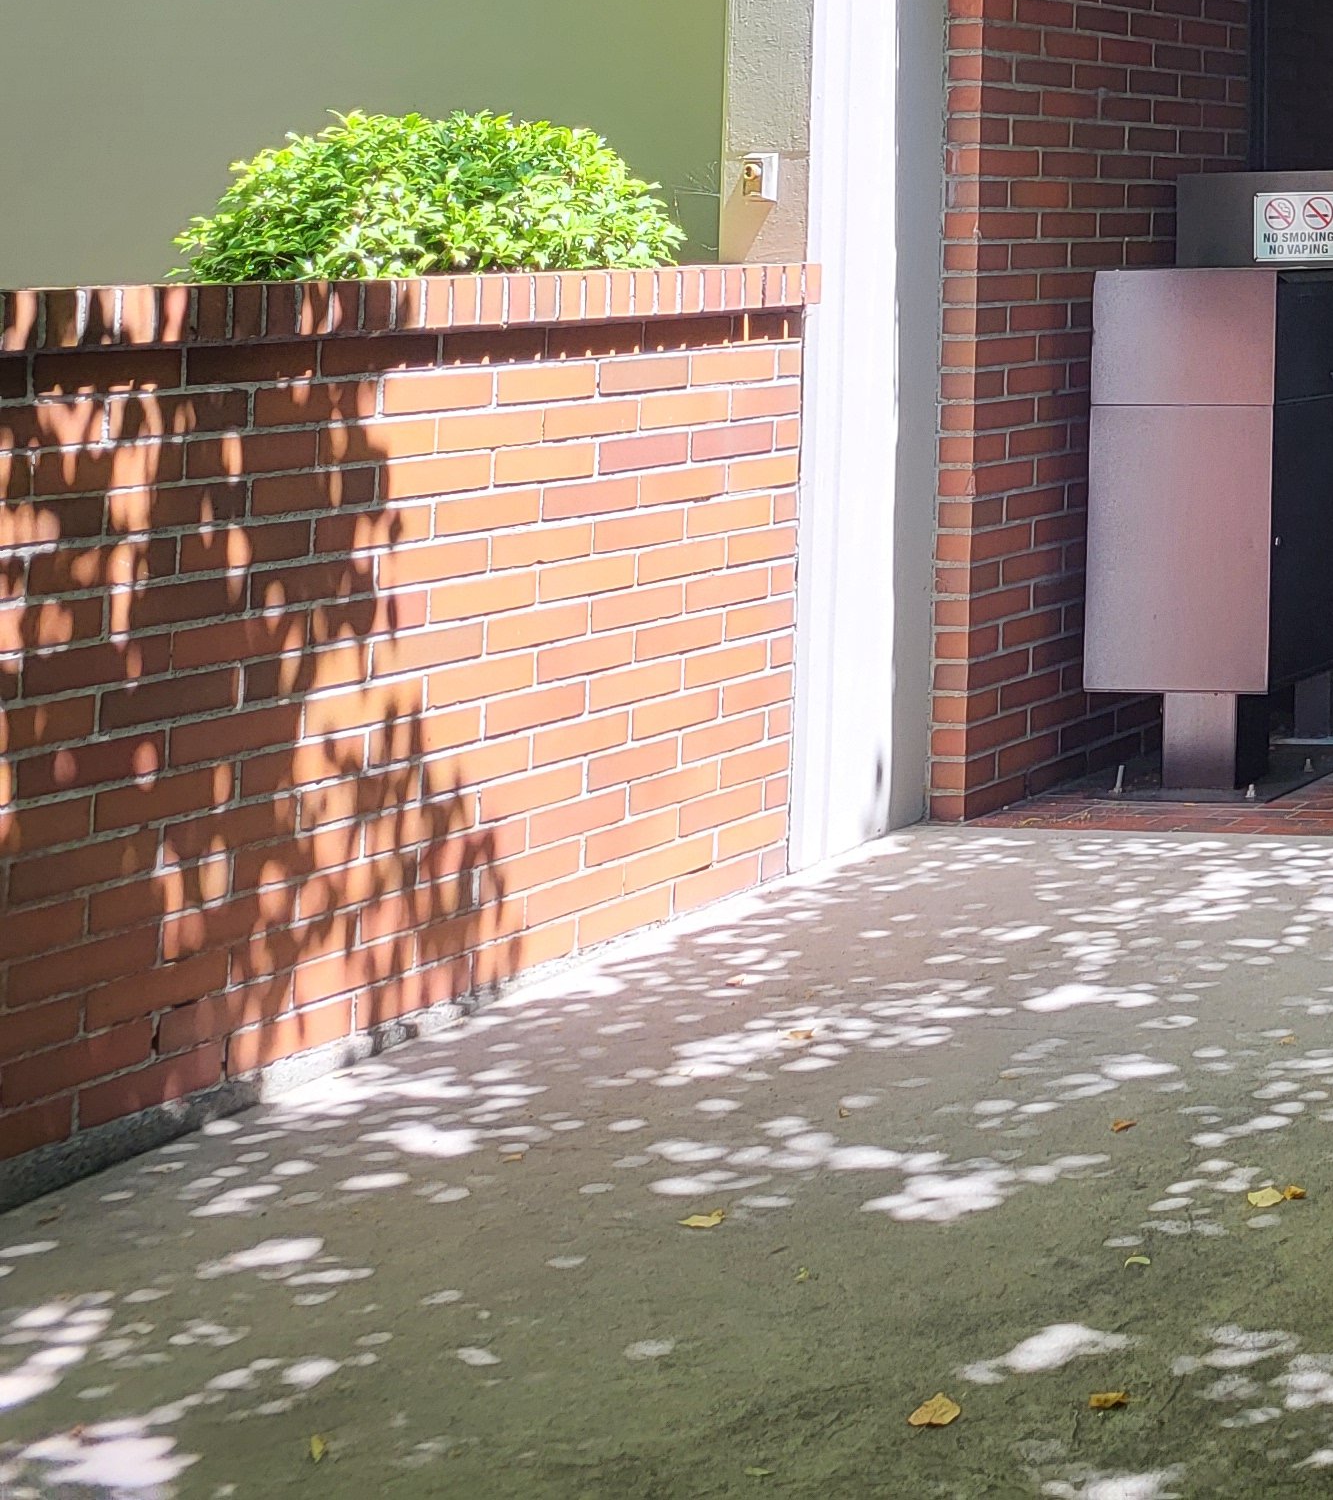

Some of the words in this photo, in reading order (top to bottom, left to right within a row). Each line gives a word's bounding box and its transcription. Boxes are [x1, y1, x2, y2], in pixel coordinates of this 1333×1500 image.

[1263, 233, 1278, 243] NO
[1282, 232, 1333, 242] SMOKING
[1269, 244, 1284, 255] NO
[1287, 244, 1329, 254] VAPING
